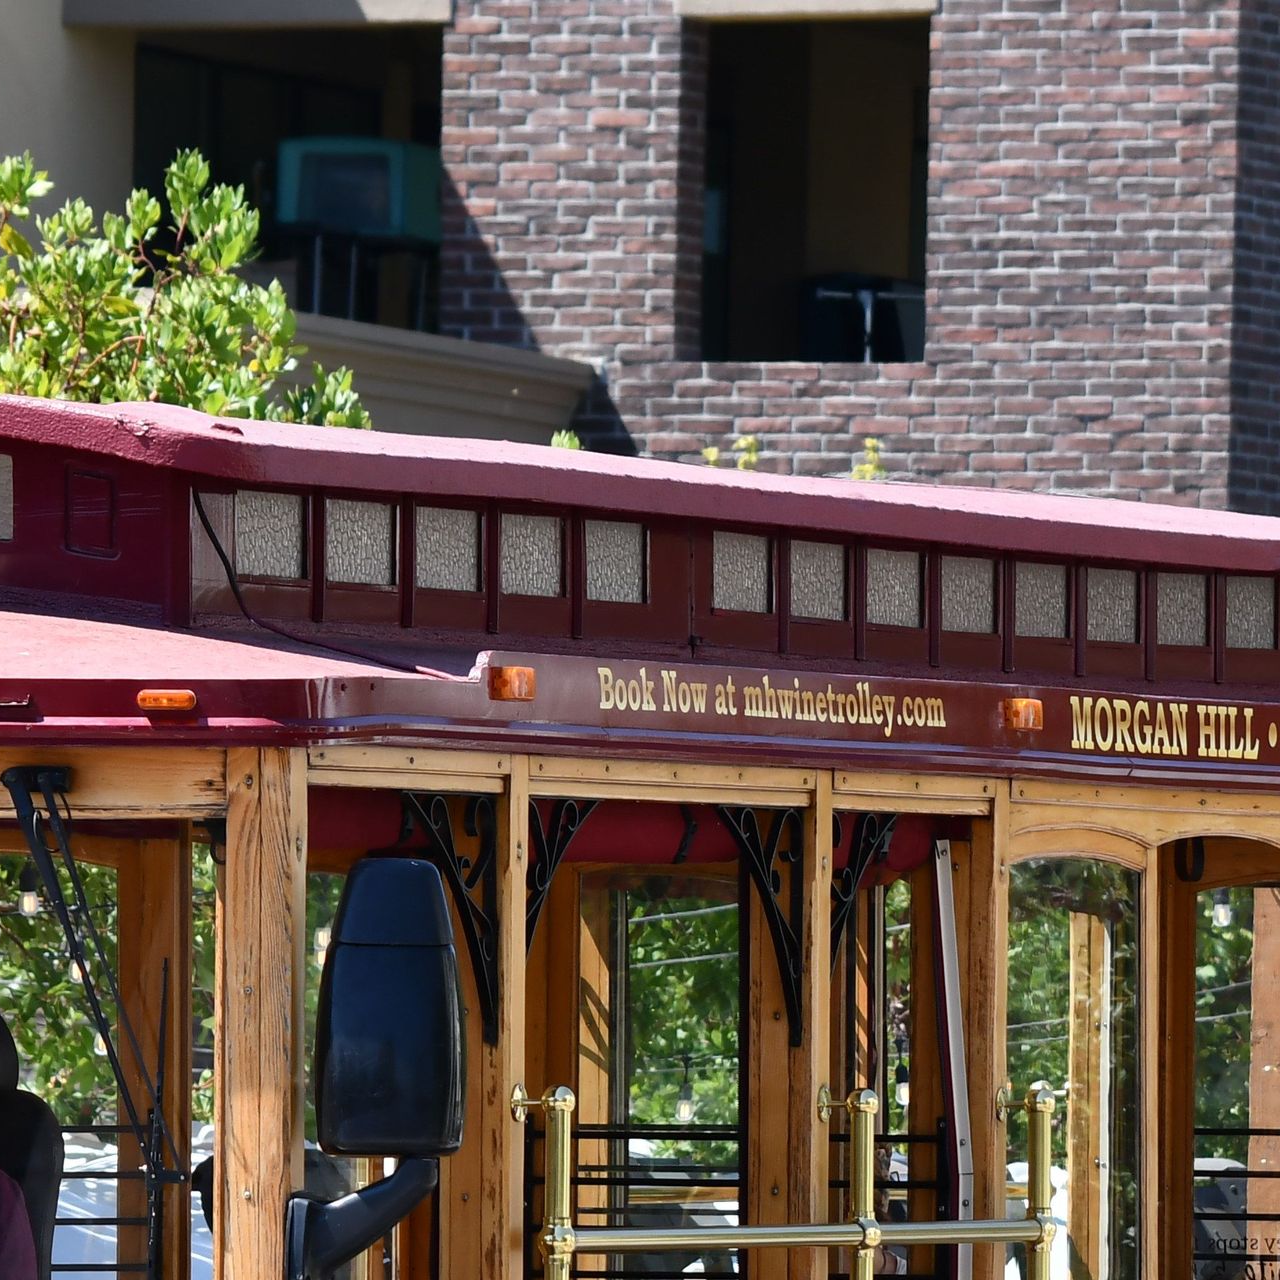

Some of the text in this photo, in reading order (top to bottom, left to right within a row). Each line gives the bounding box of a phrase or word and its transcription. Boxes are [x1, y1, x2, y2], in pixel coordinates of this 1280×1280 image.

[597, 666, 947, 738] Book Now at mhwinetrolley.com
[1070, 695, 1188, 757] MORGAN
[1196, 704, 1260, 760] HILL
